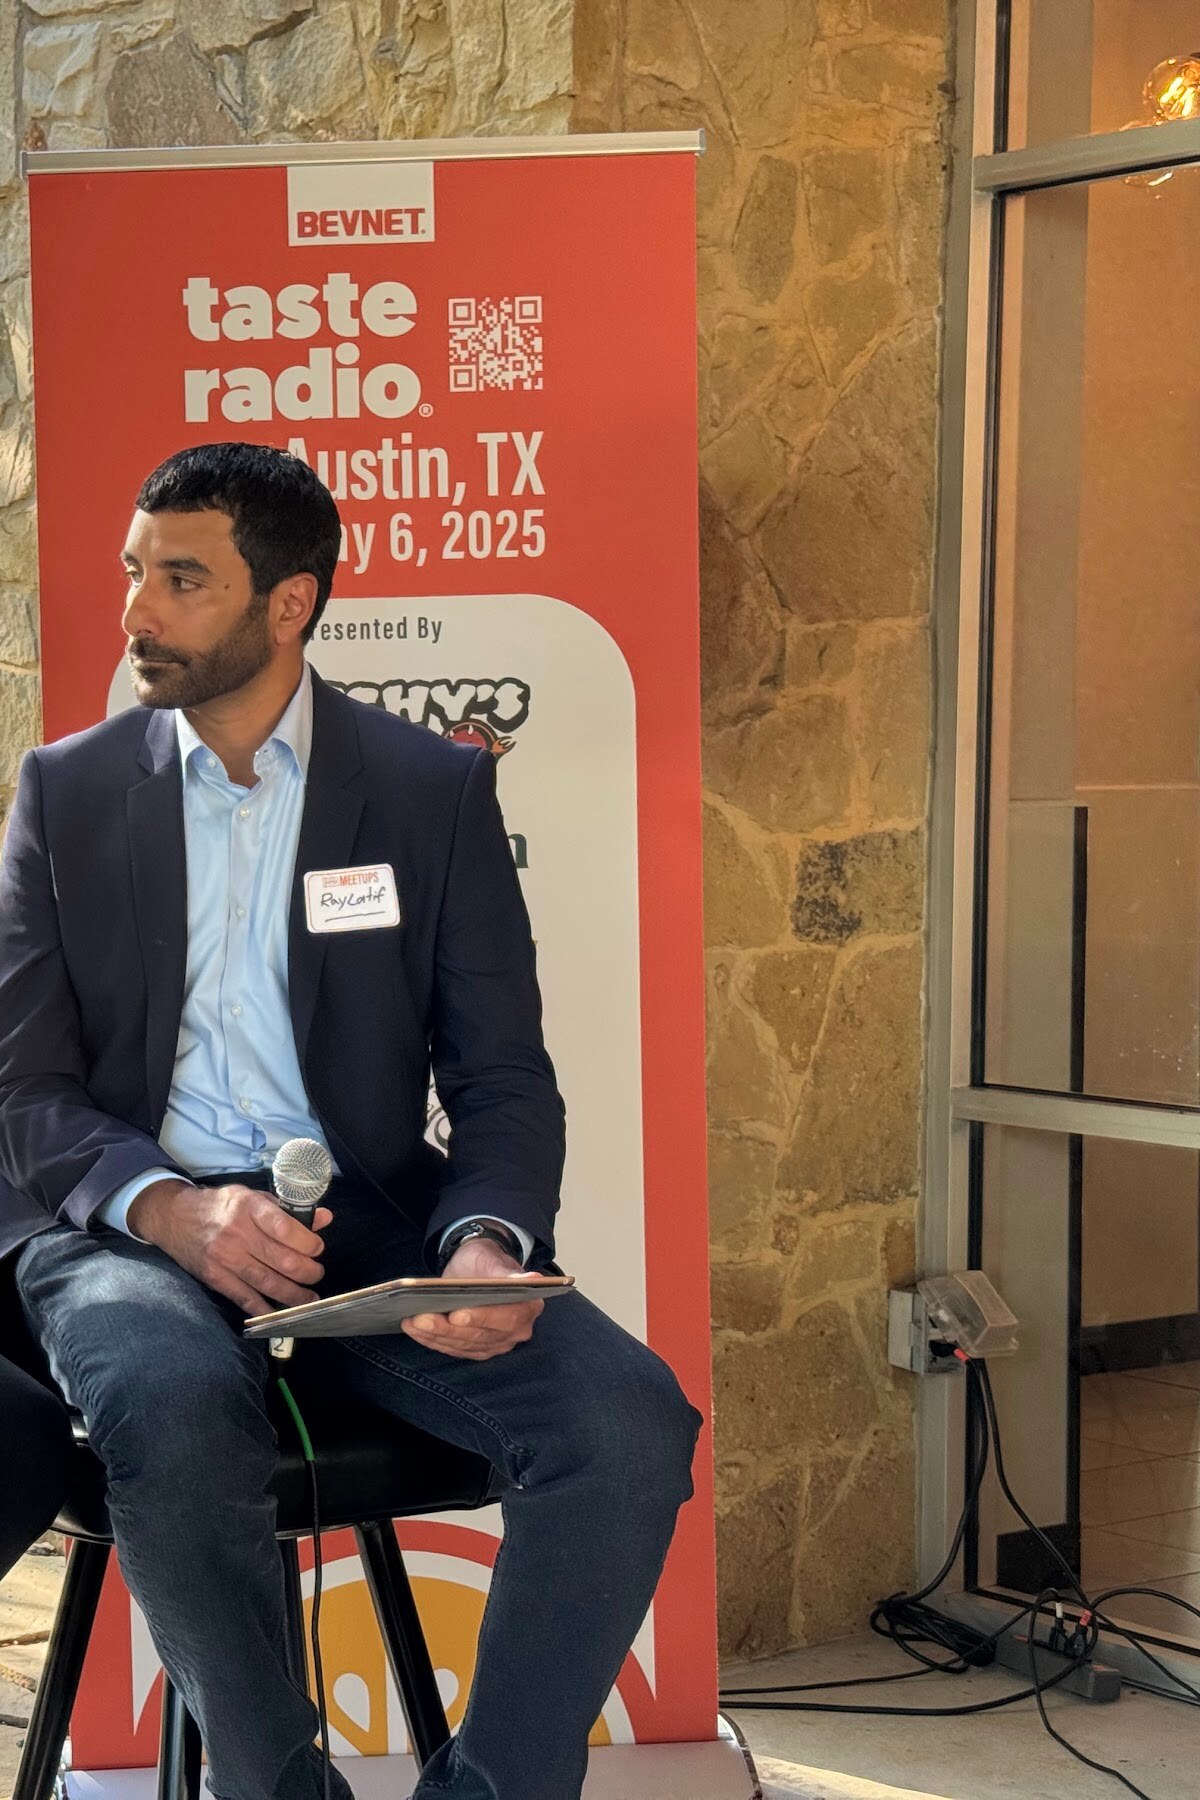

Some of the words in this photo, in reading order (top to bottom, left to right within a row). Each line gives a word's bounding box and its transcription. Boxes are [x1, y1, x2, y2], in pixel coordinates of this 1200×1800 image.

[183, 272, 417, 342] taste
[476, 431, 546, 496] TX
[390, 512, 428, 567] 6,
[441, 509, 546, 560] 2025
[311, 617, 407, 641] esented
[417, 617, 442, 643] By
[340, 872, 379, 886] MEETUPS
[273, 1337, 284, 1352] 2
